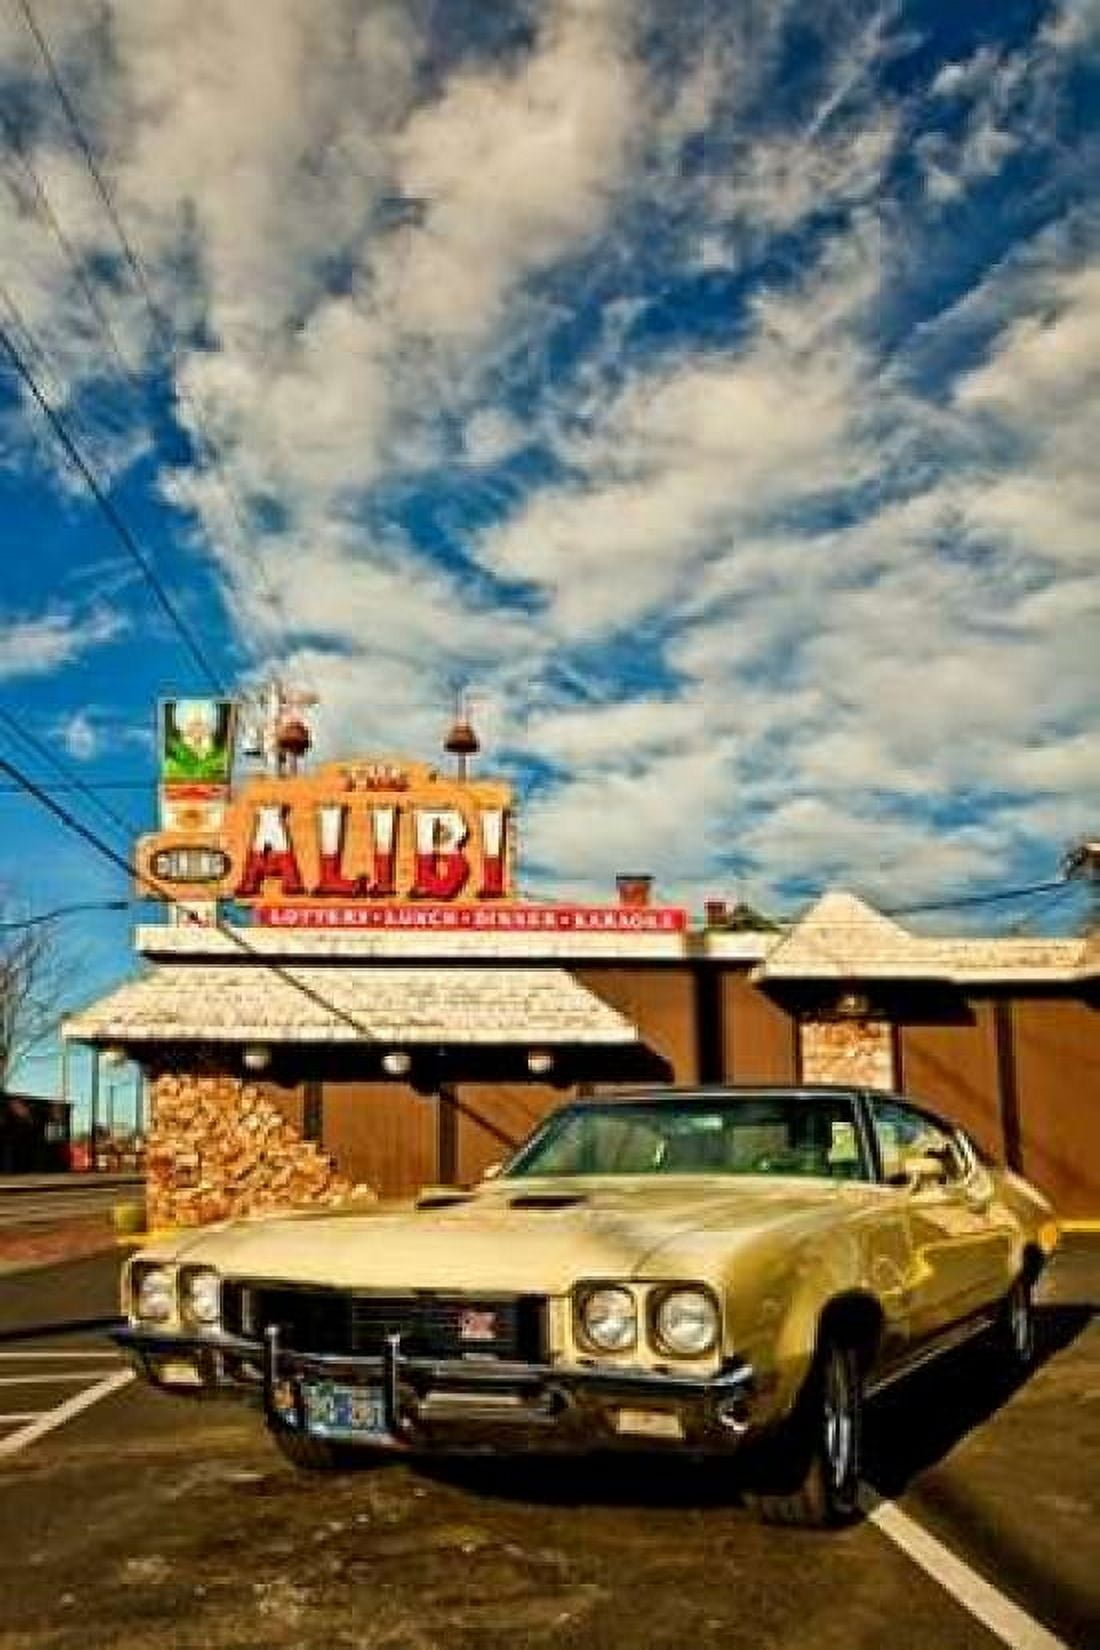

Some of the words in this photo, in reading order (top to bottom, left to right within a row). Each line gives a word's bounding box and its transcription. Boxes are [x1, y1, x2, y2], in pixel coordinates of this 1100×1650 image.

[234, 804, 511, 898] ALIBI
[271, 908, 368, 925] LOTTERY
[384, 909, 457, 926] LUNCH
